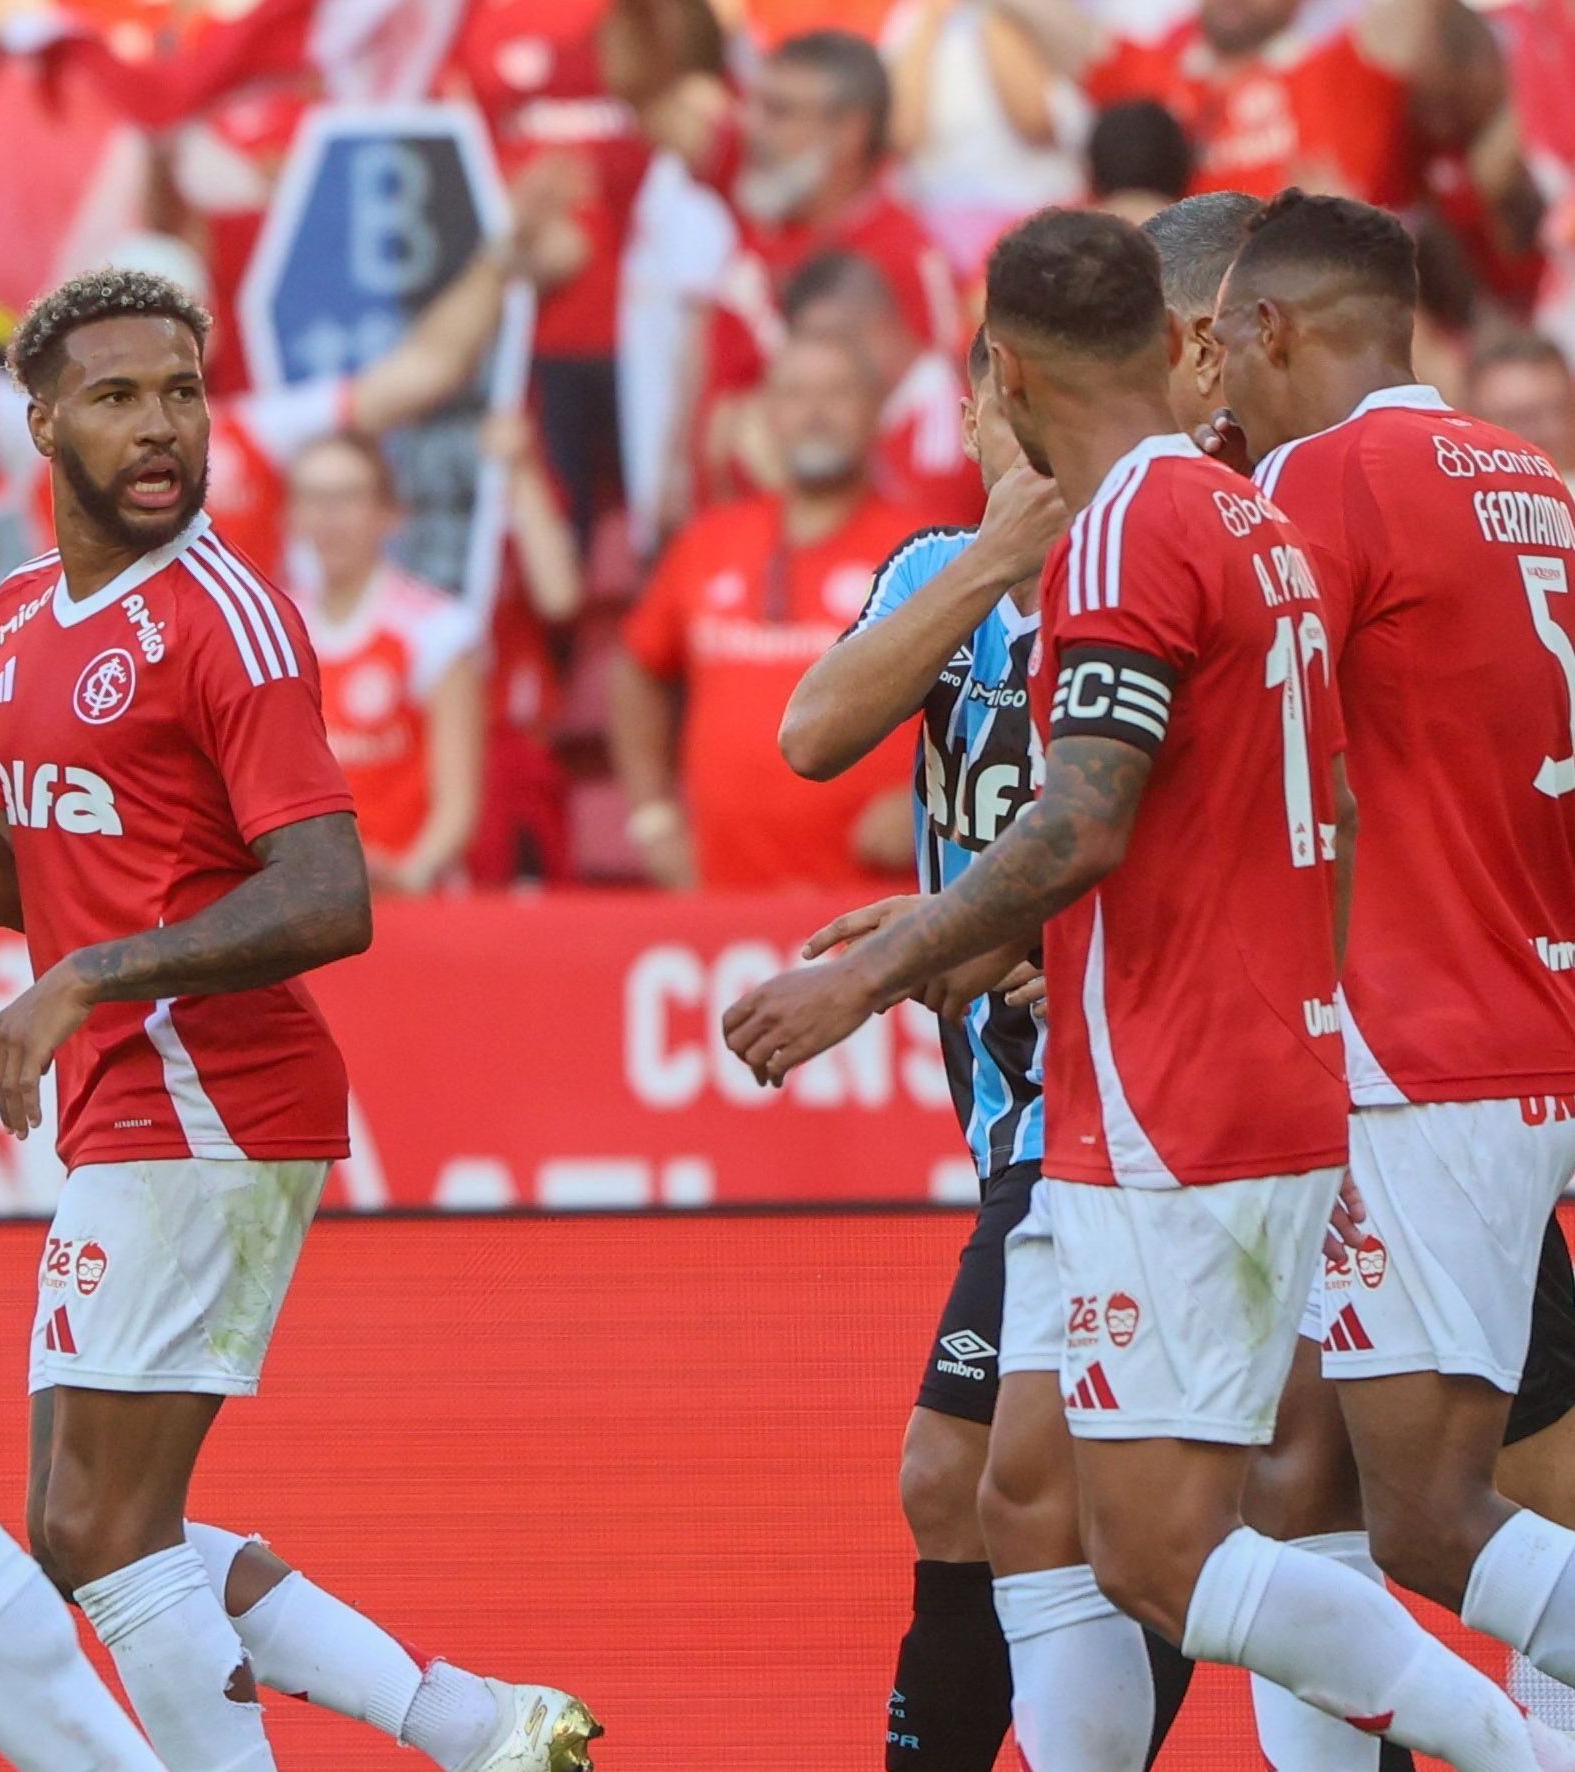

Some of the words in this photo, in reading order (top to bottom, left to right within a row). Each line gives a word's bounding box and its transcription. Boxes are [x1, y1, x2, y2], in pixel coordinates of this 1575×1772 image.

[1462, 442, 1564, 485] banris
[1516, 554, 1575, 799] 5
[47, 1237, 72, 1276] Zé
[1068, 1295, 1099, 1335] Zé
[936, 1359, 986, 1380] umbro
